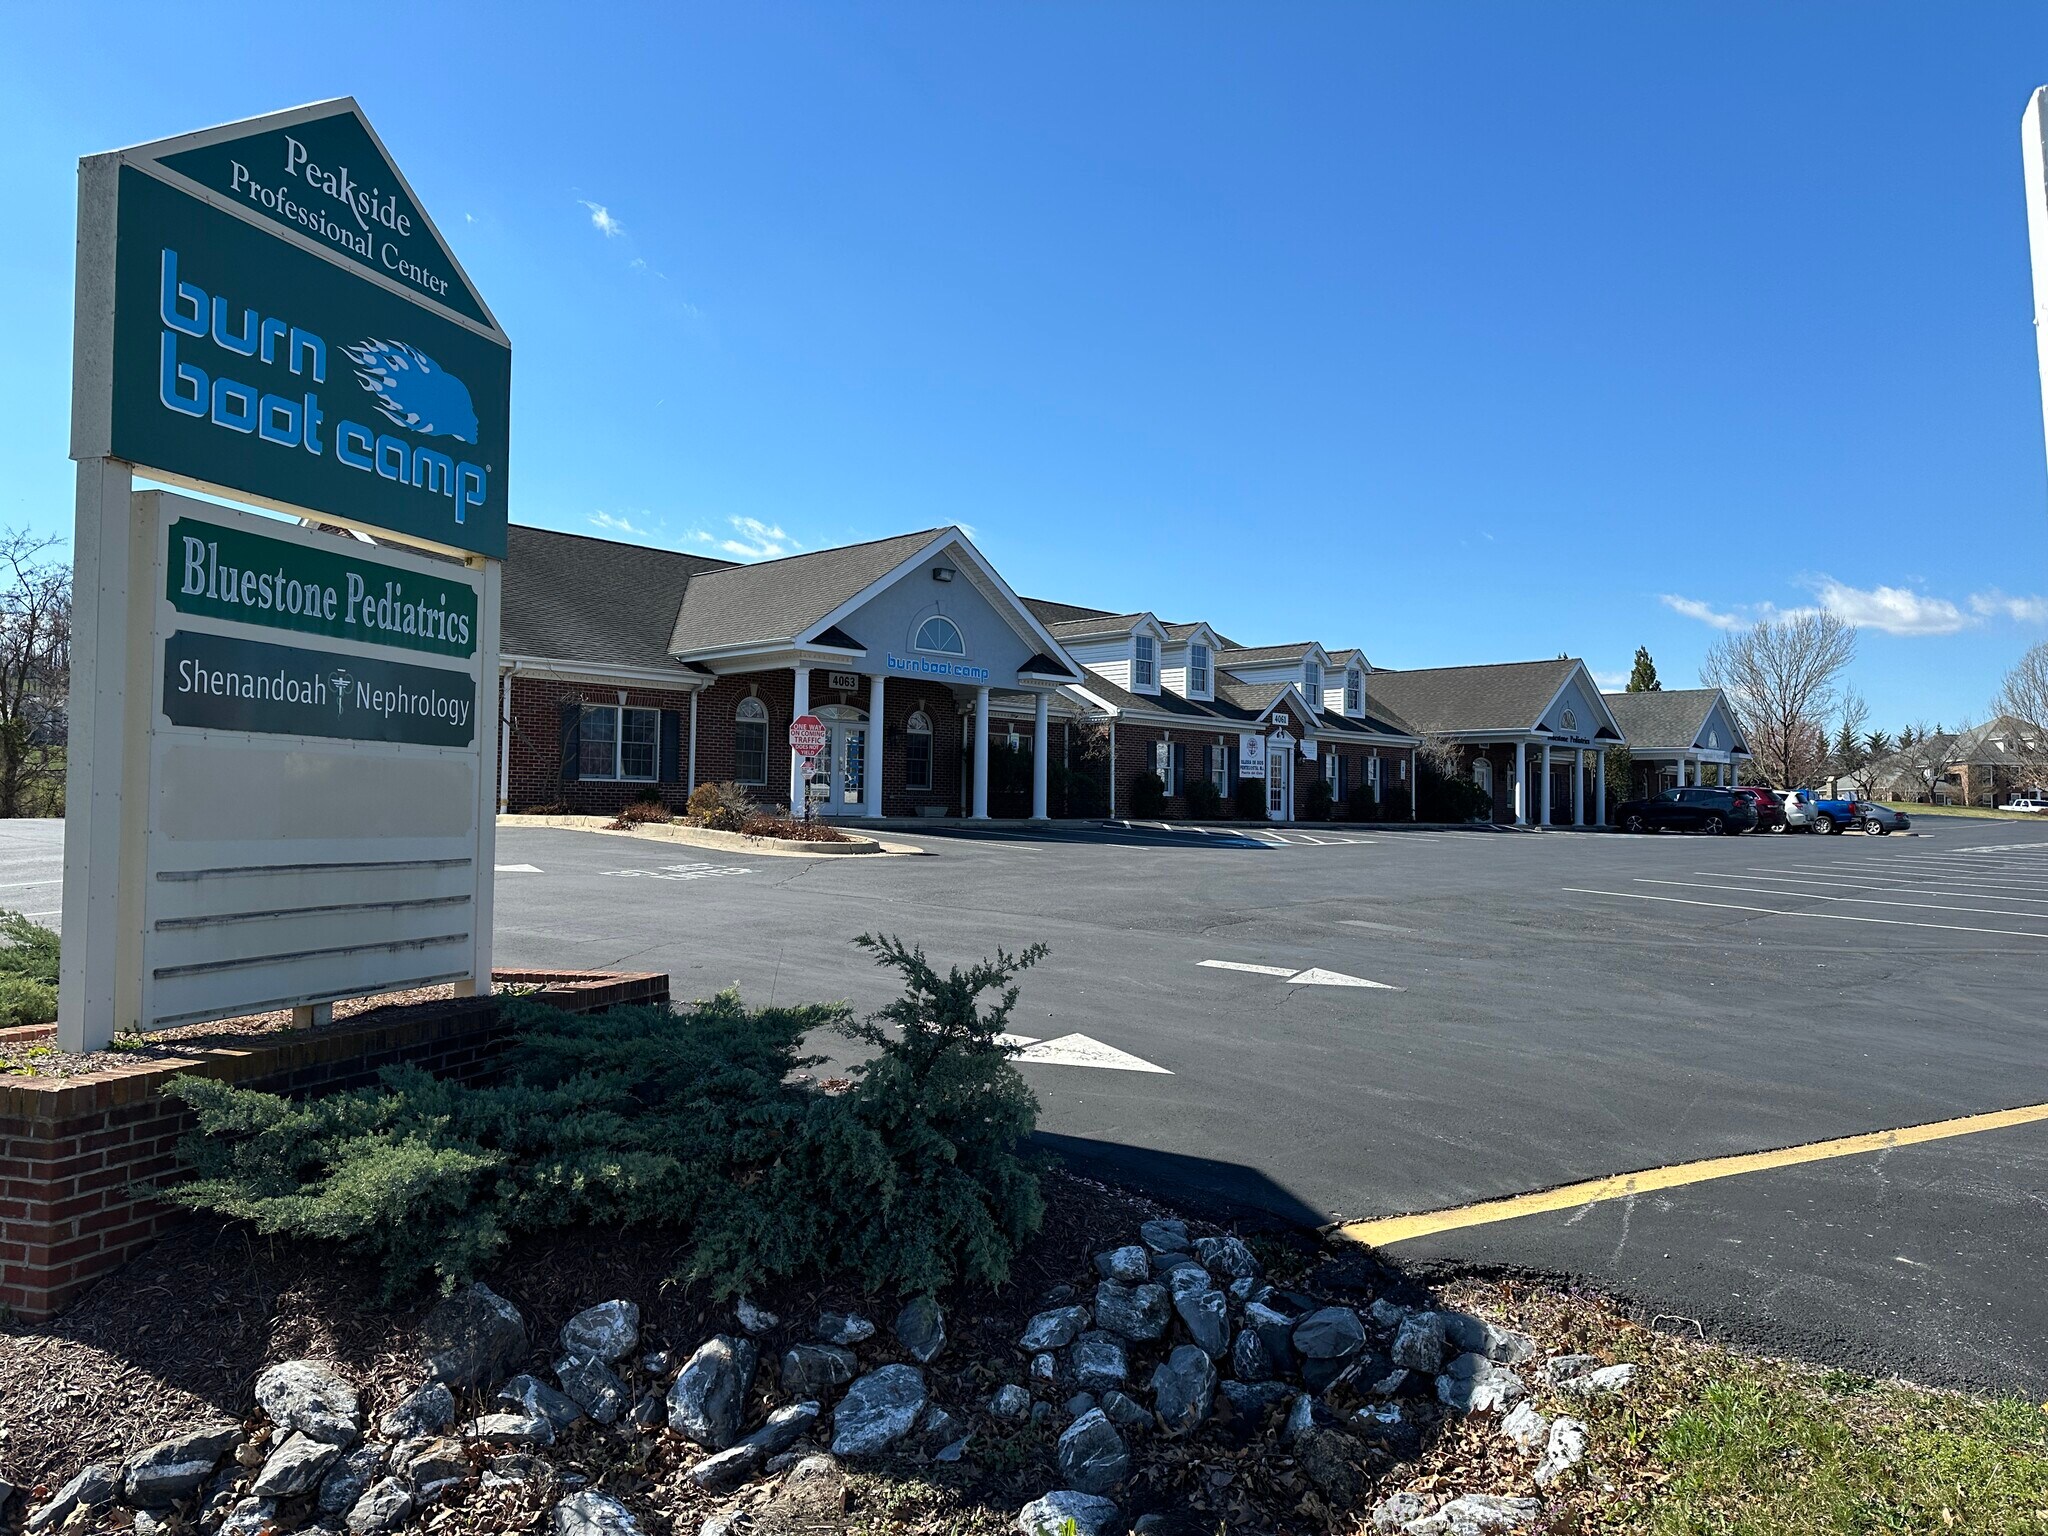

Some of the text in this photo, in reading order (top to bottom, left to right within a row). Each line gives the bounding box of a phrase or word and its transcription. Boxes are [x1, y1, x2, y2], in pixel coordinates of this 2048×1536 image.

[230, 160, 448, 297] Professional Center
[284, 135, 411, 237] Peakside
[160, 248, 327, 384] burn
[160, 329, 487, 525] boot camp
[181, 536, 469, 644] Bluestone Pediatrics
[178, 659, 469, 726] Shenandoah Nephrology
[832, 675, 856, 687] 4063
[887, 652, 989, 684] burn boot camp
